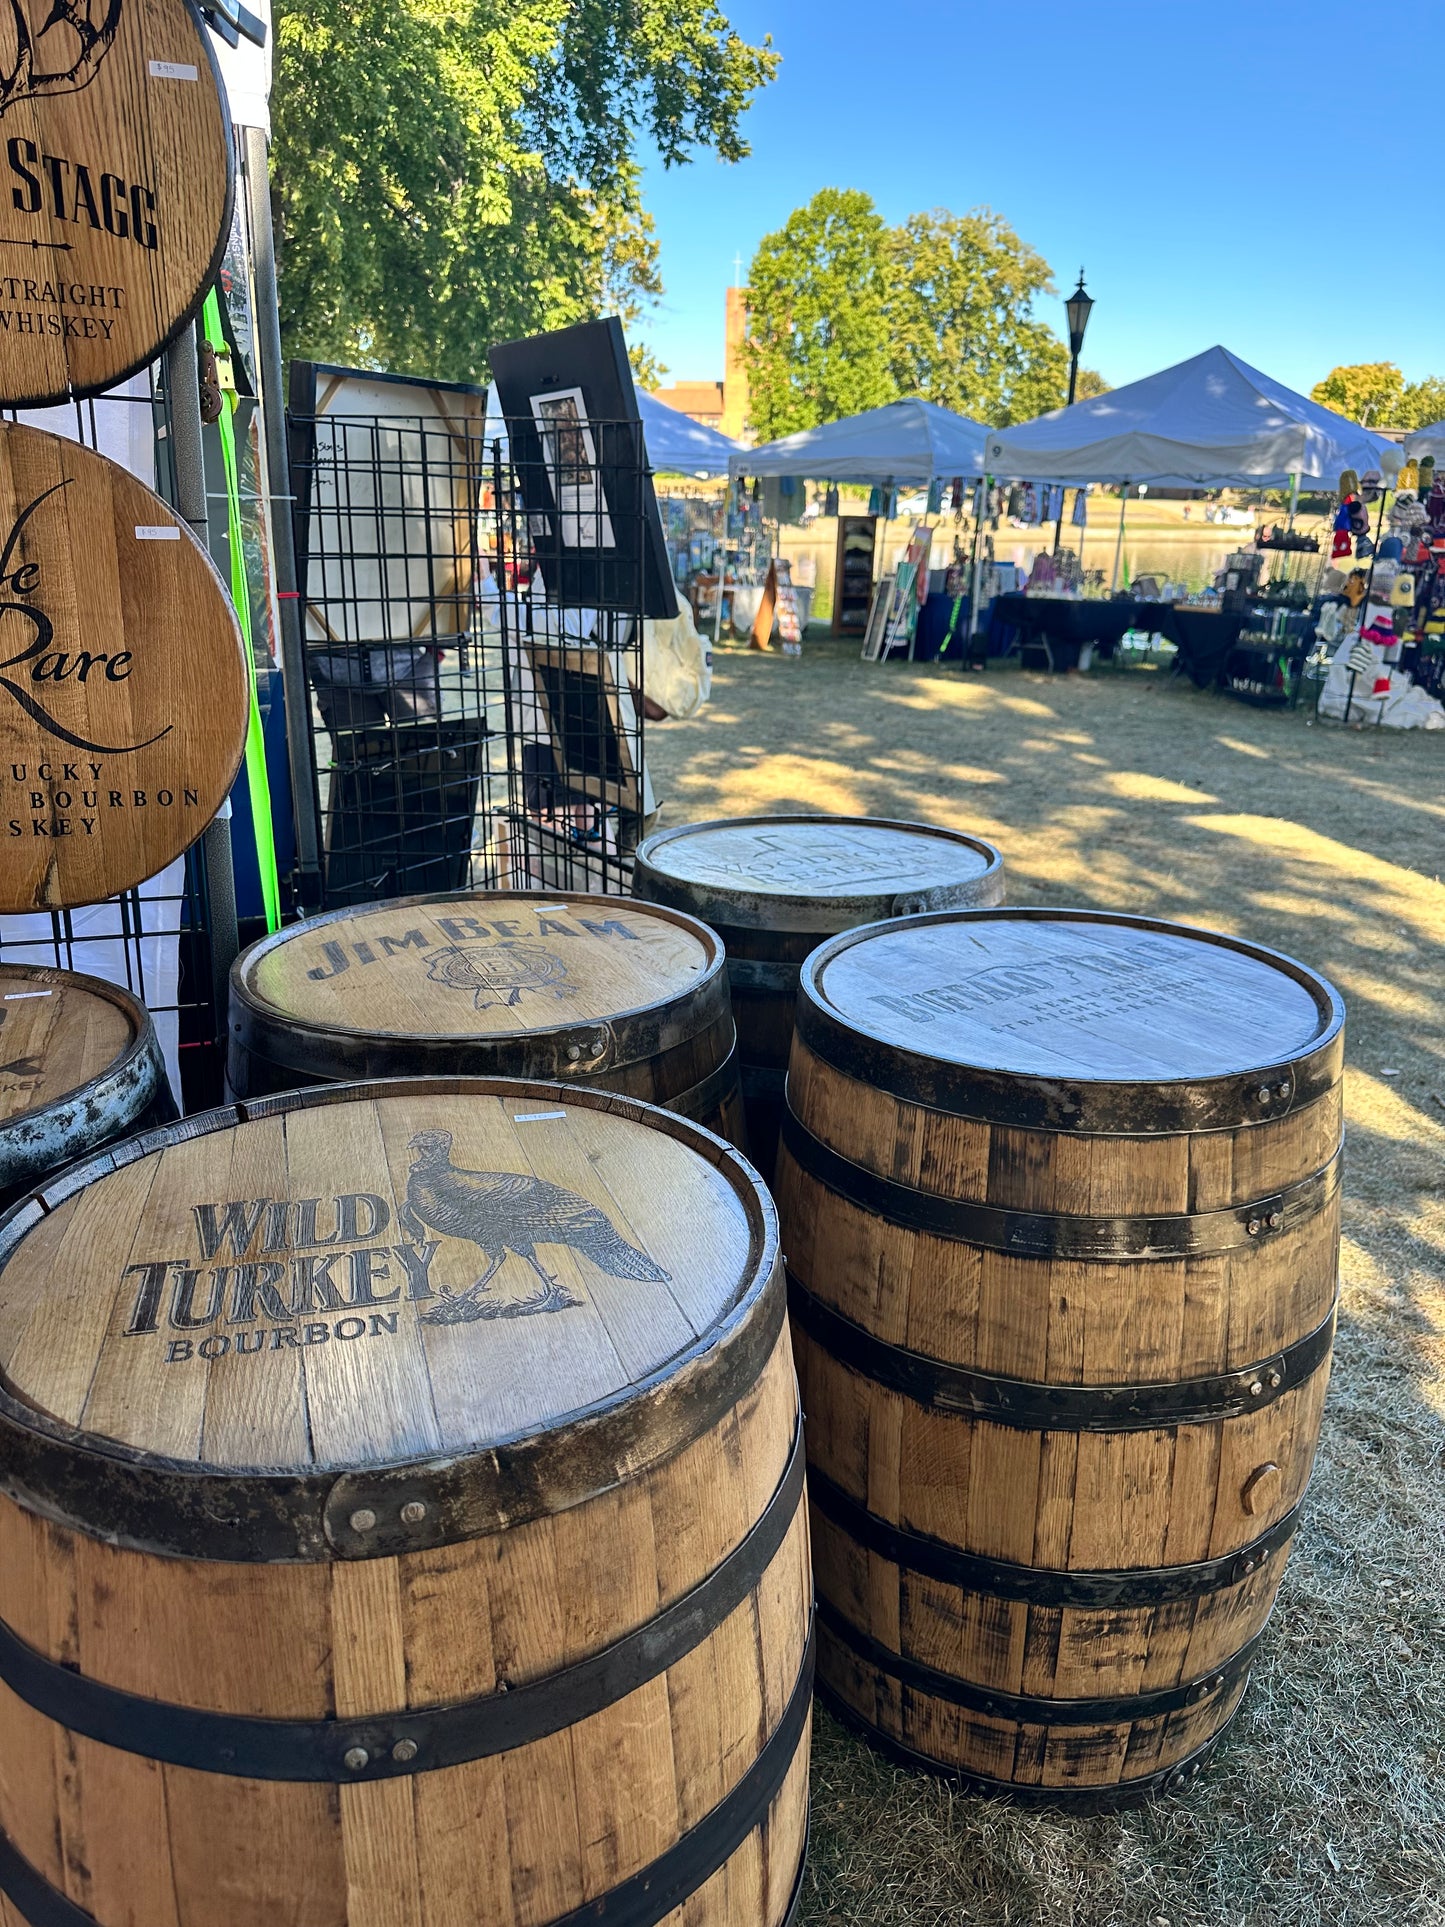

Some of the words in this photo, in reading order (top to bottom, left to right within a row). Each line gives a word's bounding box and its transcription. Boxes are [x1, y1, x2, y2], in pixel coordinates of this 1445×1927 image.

[7, 137, 158, 251] STAGG
[10, 763, 103, 782] UCKY
[29, 789, 199, 809] BOURBON
[9, 818, 96, 837] SKEY
[744, 857, 938, 885] RESERVE
[306, 928, 432, 981] JIM
[436, 917, 642, 941] BEAM
[866, 971, 1056, 1024] BUFFALO
[990, 1000, 1103, 1034] STRAIGHT
[1110, 977, 1209, 1003] BOURBON
[1029, 980, 1142, 1012] KENTUCKY
[1070, 995, 1171, 1024] WHISKEY
[191, 1192, 392, 1262] WILD
[122, 1240, 443, 1338] TURKEY
[164, 1311, 400, 1363] BOURBON
